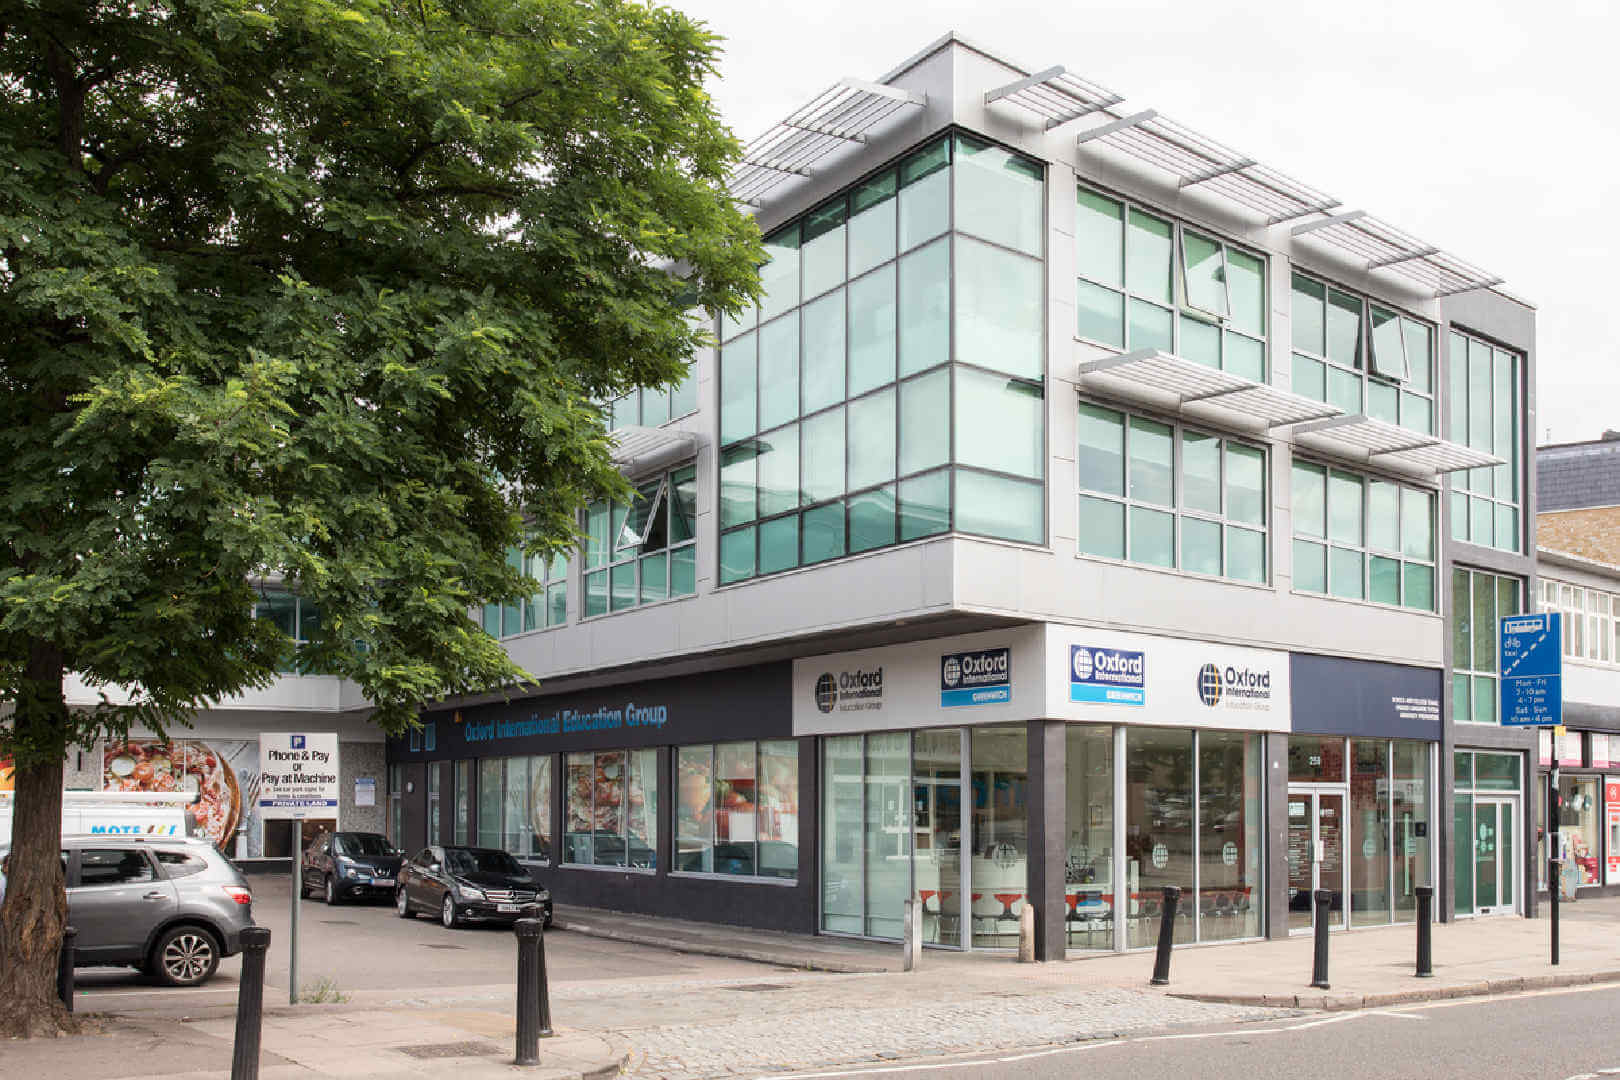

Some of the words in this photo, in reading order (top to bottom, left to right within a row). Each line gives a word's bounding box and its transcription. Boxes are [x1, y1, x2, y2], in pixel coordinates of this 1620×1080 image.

[963, 652, 1007, 673] Oxford
[1095, 651, 1143, 673] Oxford
[839, 667, 882, 688] Oxford
[1225, 666, 1270, 687] Oxford
[1225, 687, 1271, 698] International
[465, 719, 495, 742] Oxford
[497, 711, 561, 738] International
[562, 705, 623, 732] Education
[625, 702, 668, 729] Group
[268, 750, 300, 761] Phone
[301, 750, 309, 761] &
[311, 750, 330, 763] Pay
[292, 762, 302, 771] or
[261, 772, 280, 786] Pay
[281, 773, 292, 784] at
[293, 772, 337, 784] Machine
